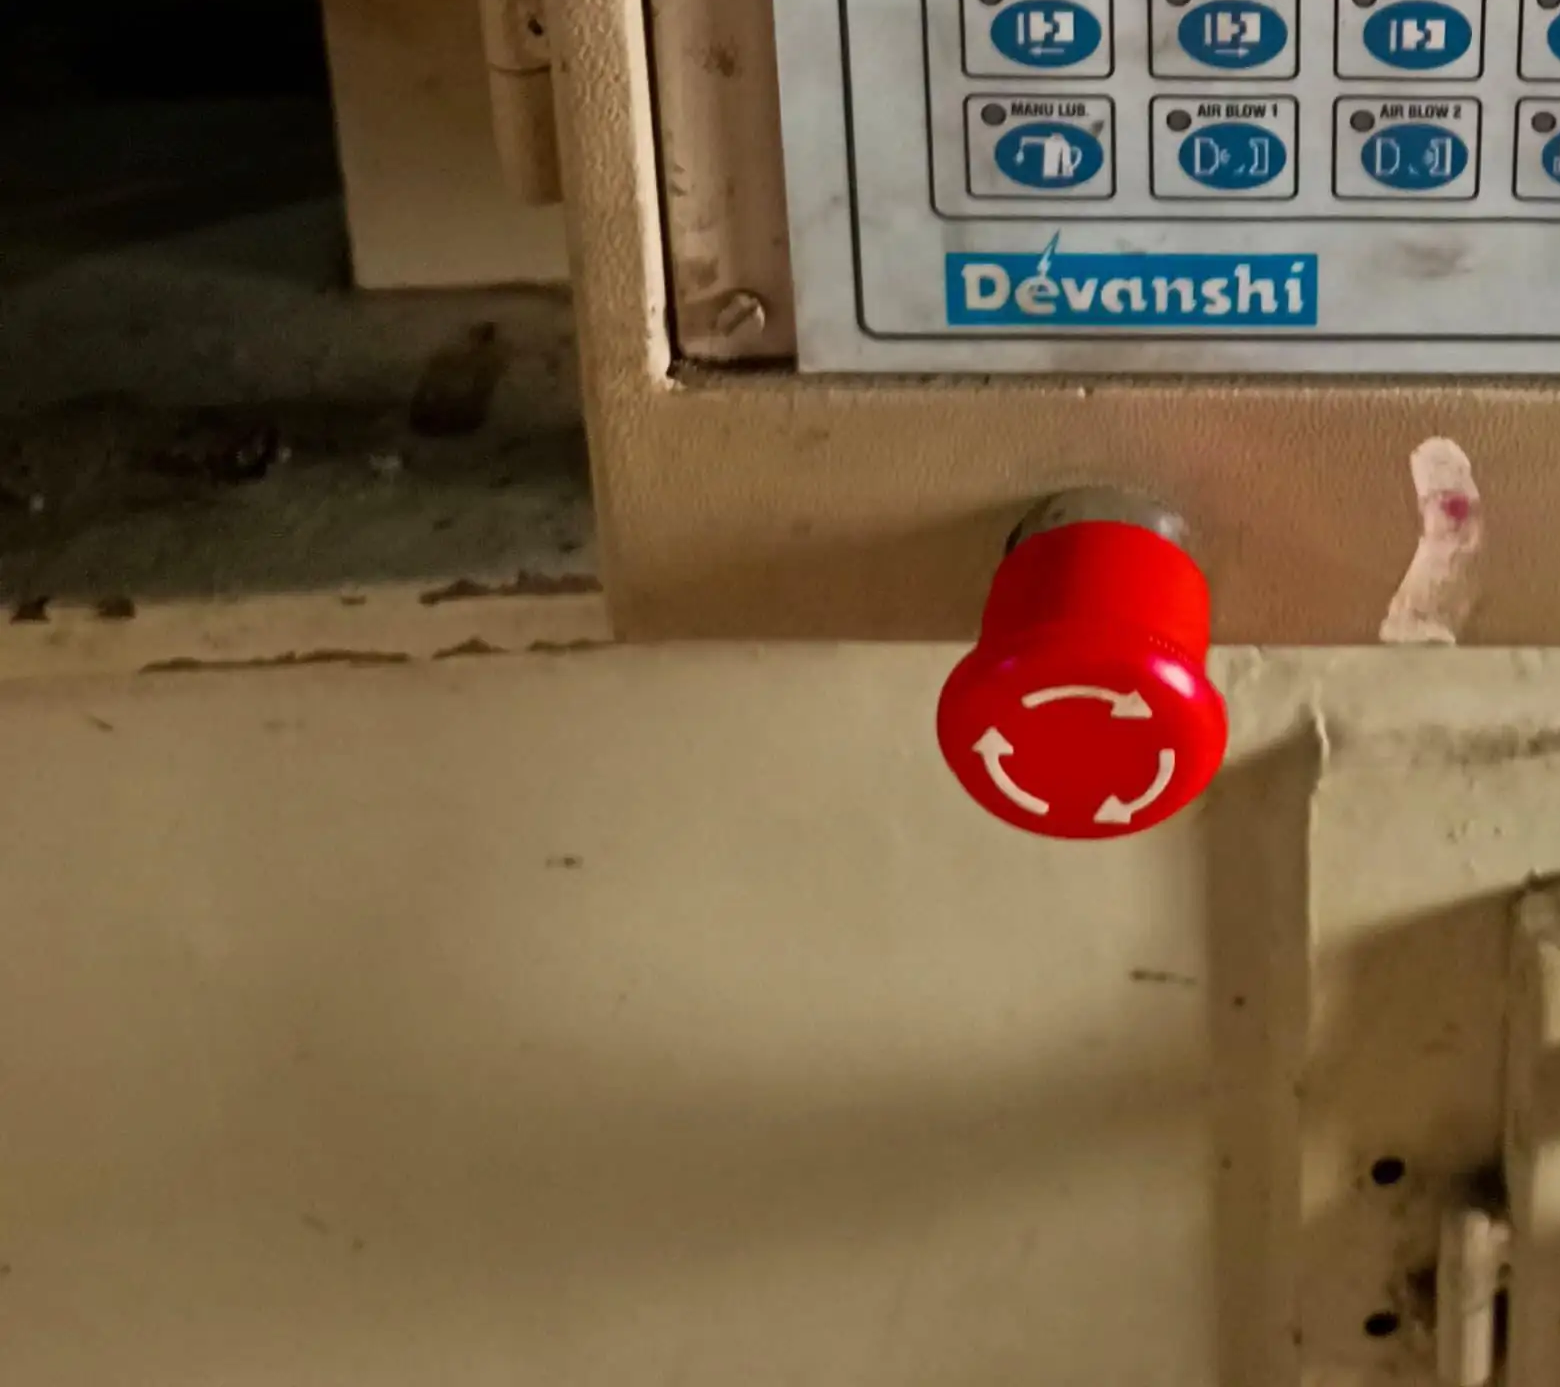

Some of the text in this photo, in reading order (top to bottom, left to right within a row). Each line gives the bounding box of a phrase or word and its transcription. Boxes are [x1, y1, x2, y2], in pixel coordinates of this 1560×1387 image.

[1010, 102, 1054, 117] MANU
[1197, 103, 1278, 119] AIR BLOW 1
[1379, 103, 1462, 120] AIR BLOW 2
